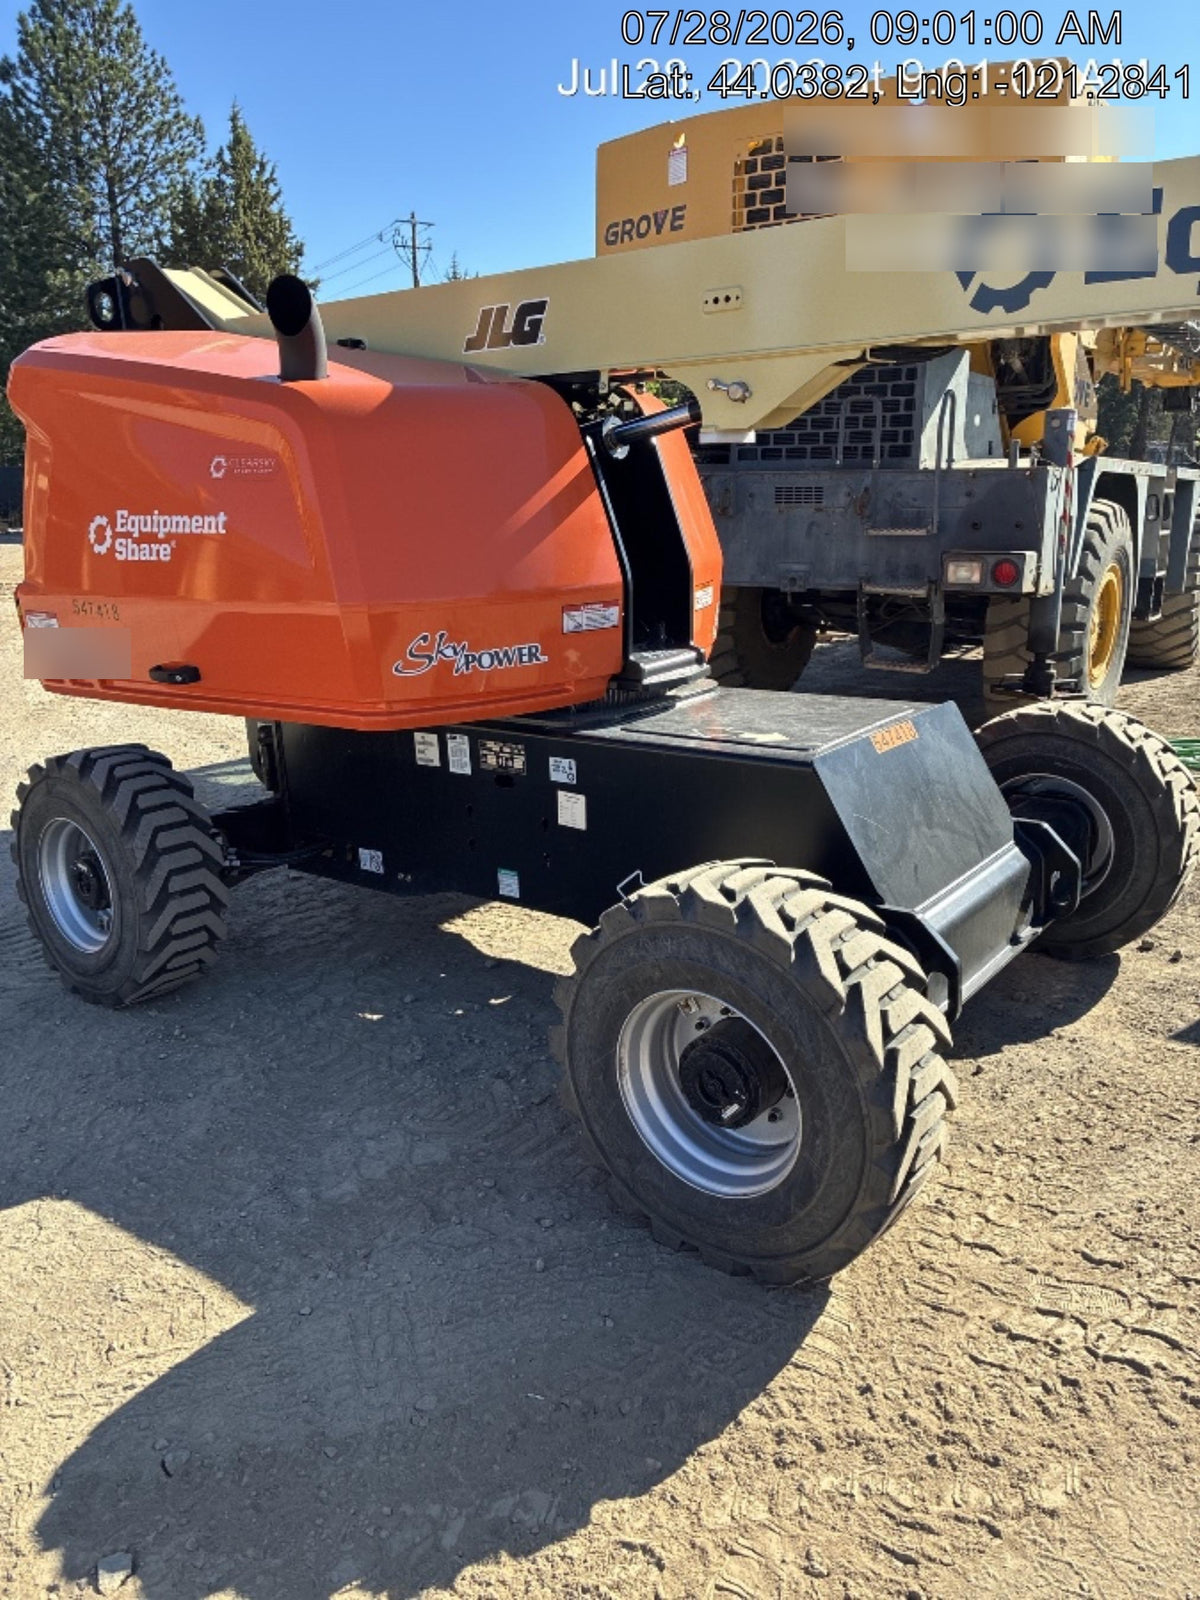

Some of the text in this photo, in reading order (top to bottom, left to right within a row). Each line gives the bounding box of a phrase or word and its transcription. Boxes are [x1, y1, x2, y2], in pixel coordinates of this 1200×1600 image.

[604, 203, 688, 246] GROVE
[462, 297, 550, 354] JLG
[115, 509, 227, 539] Equipment
[115, 538, 172, 562] Share
